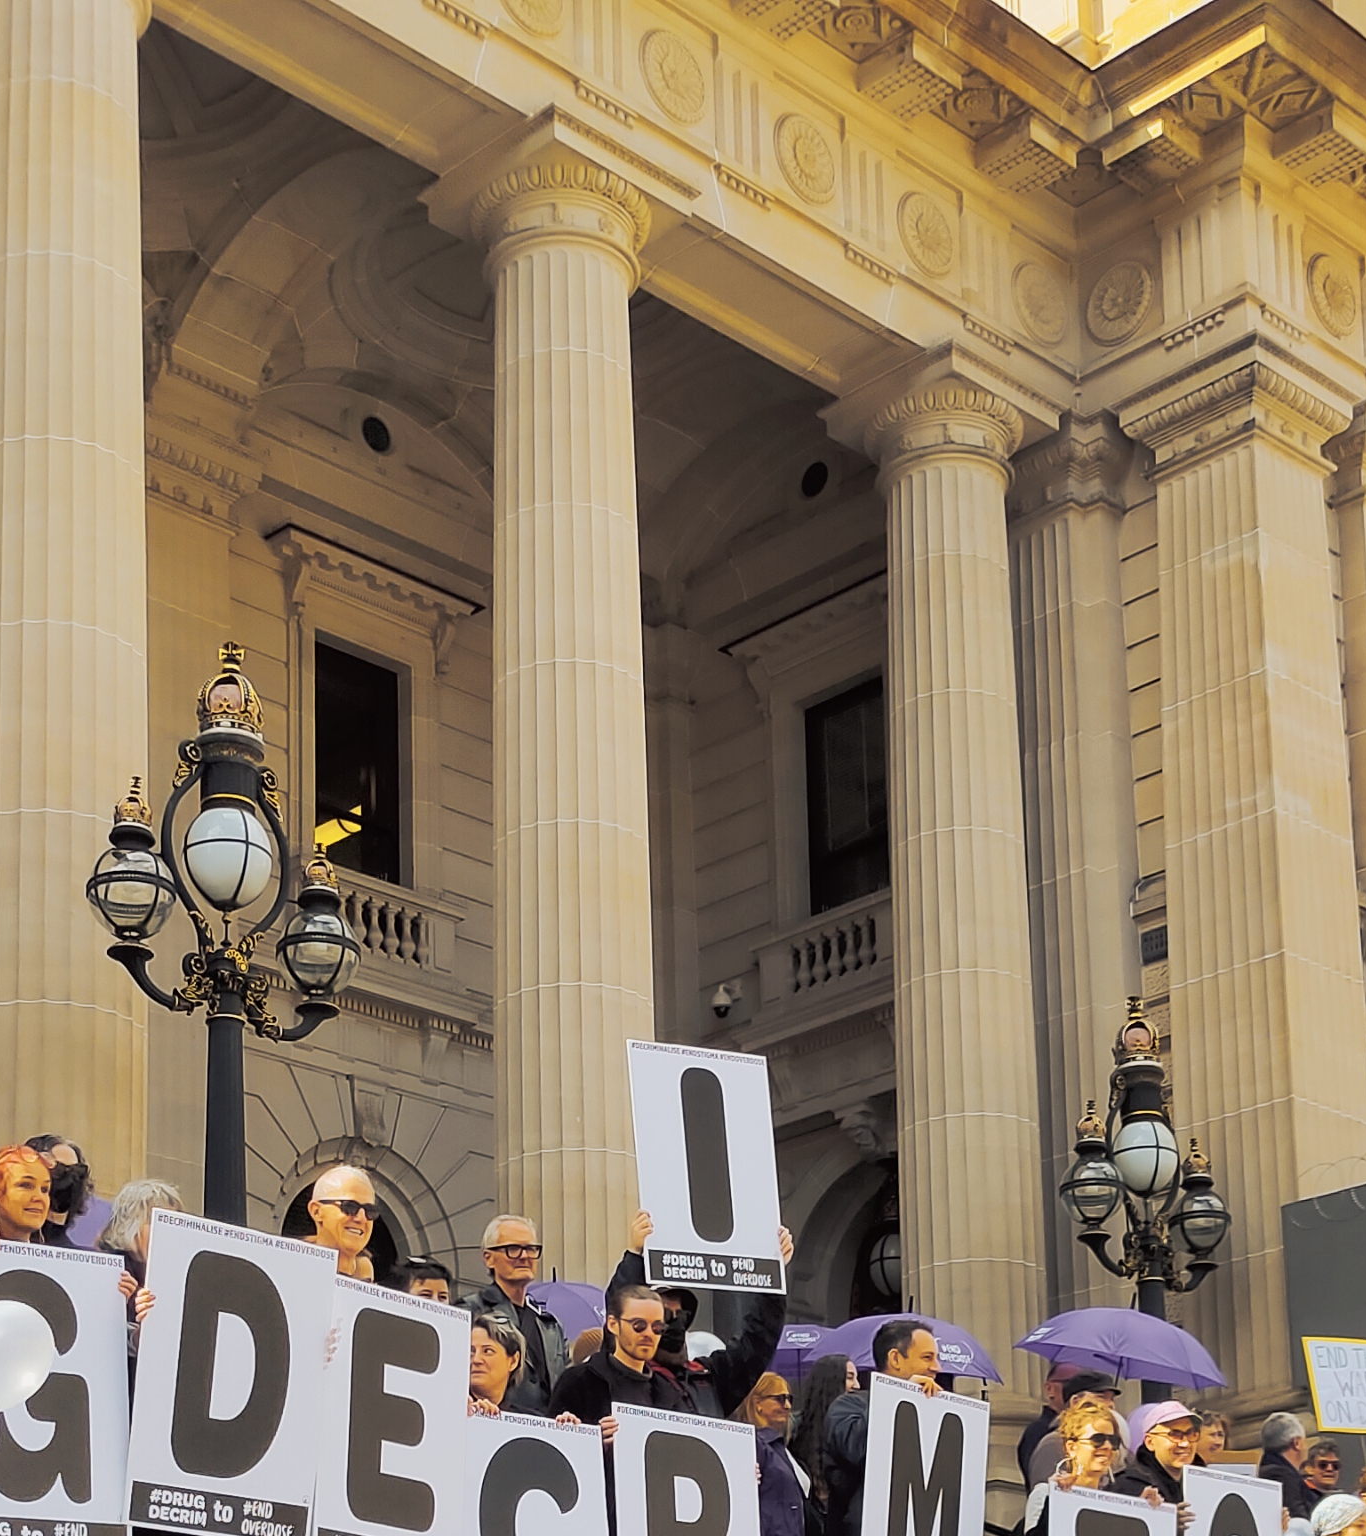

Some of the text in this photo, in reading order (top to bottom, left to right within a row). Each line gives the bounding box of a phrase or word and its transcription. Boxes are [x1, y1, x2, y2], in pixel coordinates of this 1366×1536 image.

[680, 1067, 735, 1243] I
[157, 1213, 336, 1261] #DECRIMINALISE #ENDSTIGMA #ENDOVERDOSE
[55, 1250, 123, 1268] #ENDOVERDOSE
[662, 1253, 755, 1277] #DRUG to #END
[663, 1266, 772, 1287] DECRIM OVERDOSE
[381, 1289, 421, 1308] #ENDSTIGMA
[170, 1250, 291, 1478] D
[1315, 1346, 1348, 1369] END
[346, 1307, 441, 1533] E
[504, 1415, 546, 1428] #ENDSTIGMA
[616, 1406, 667, 1420] #DECRIMINALISE
[668, 1414, 707, 1428] #ENDSTIGMA
[1325, 1400, 1352, 1424] ON
[148, 1504, 208, 1527] DECRIM
[149, 1488, 273, 1523] #DRUG to #END
